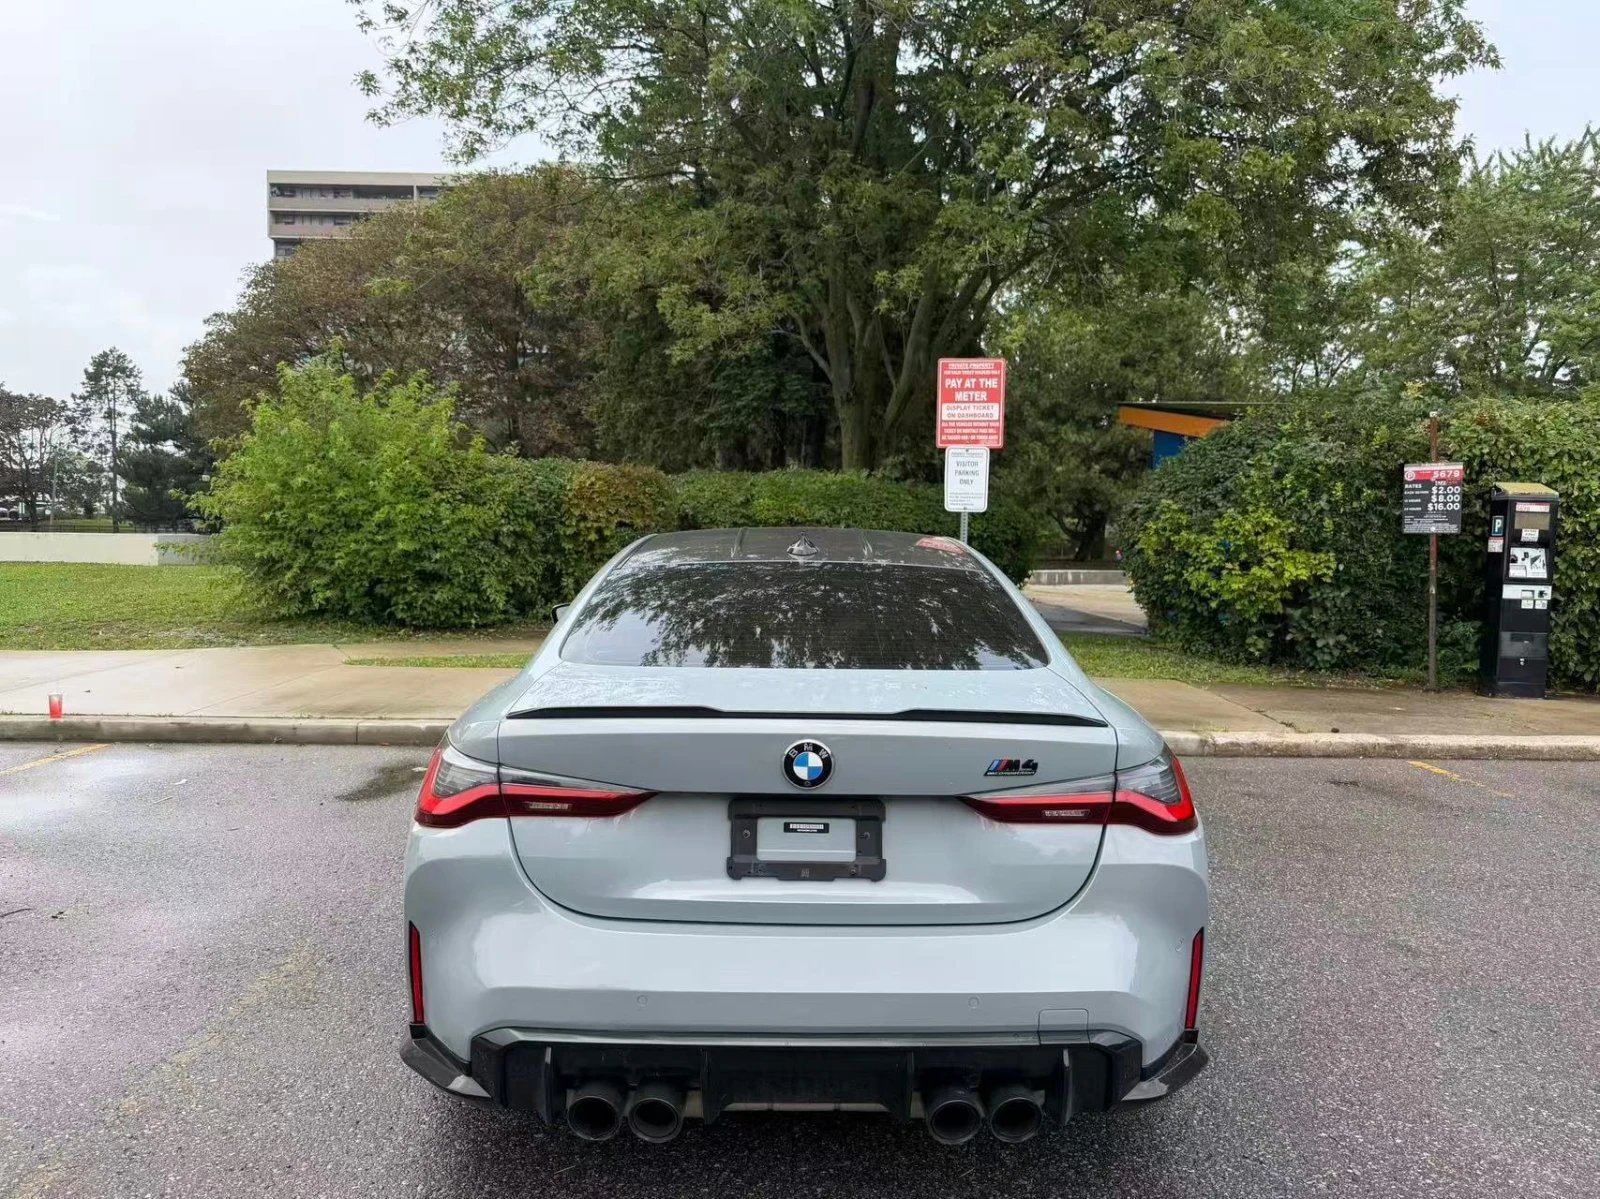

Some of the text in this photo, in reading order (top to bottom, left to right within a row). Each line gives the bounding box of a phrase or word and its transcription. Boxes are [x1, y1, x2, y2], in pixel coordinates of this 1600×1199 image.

[945, 378, 998, 389] PAY AT THE
[955, 391, 987, 401] METER
[1433, 470, 1460, 478] 5679
[1431, 486, 1461, 494] $2.00
[1431, 494, 1460, 503] $8.00
[1427, 502, 1460, 511] $16.00
[1495, 518, 1502, 532] P
[789, 743, 829, 759] BMW
[998, 759, 1038, 772] M4
